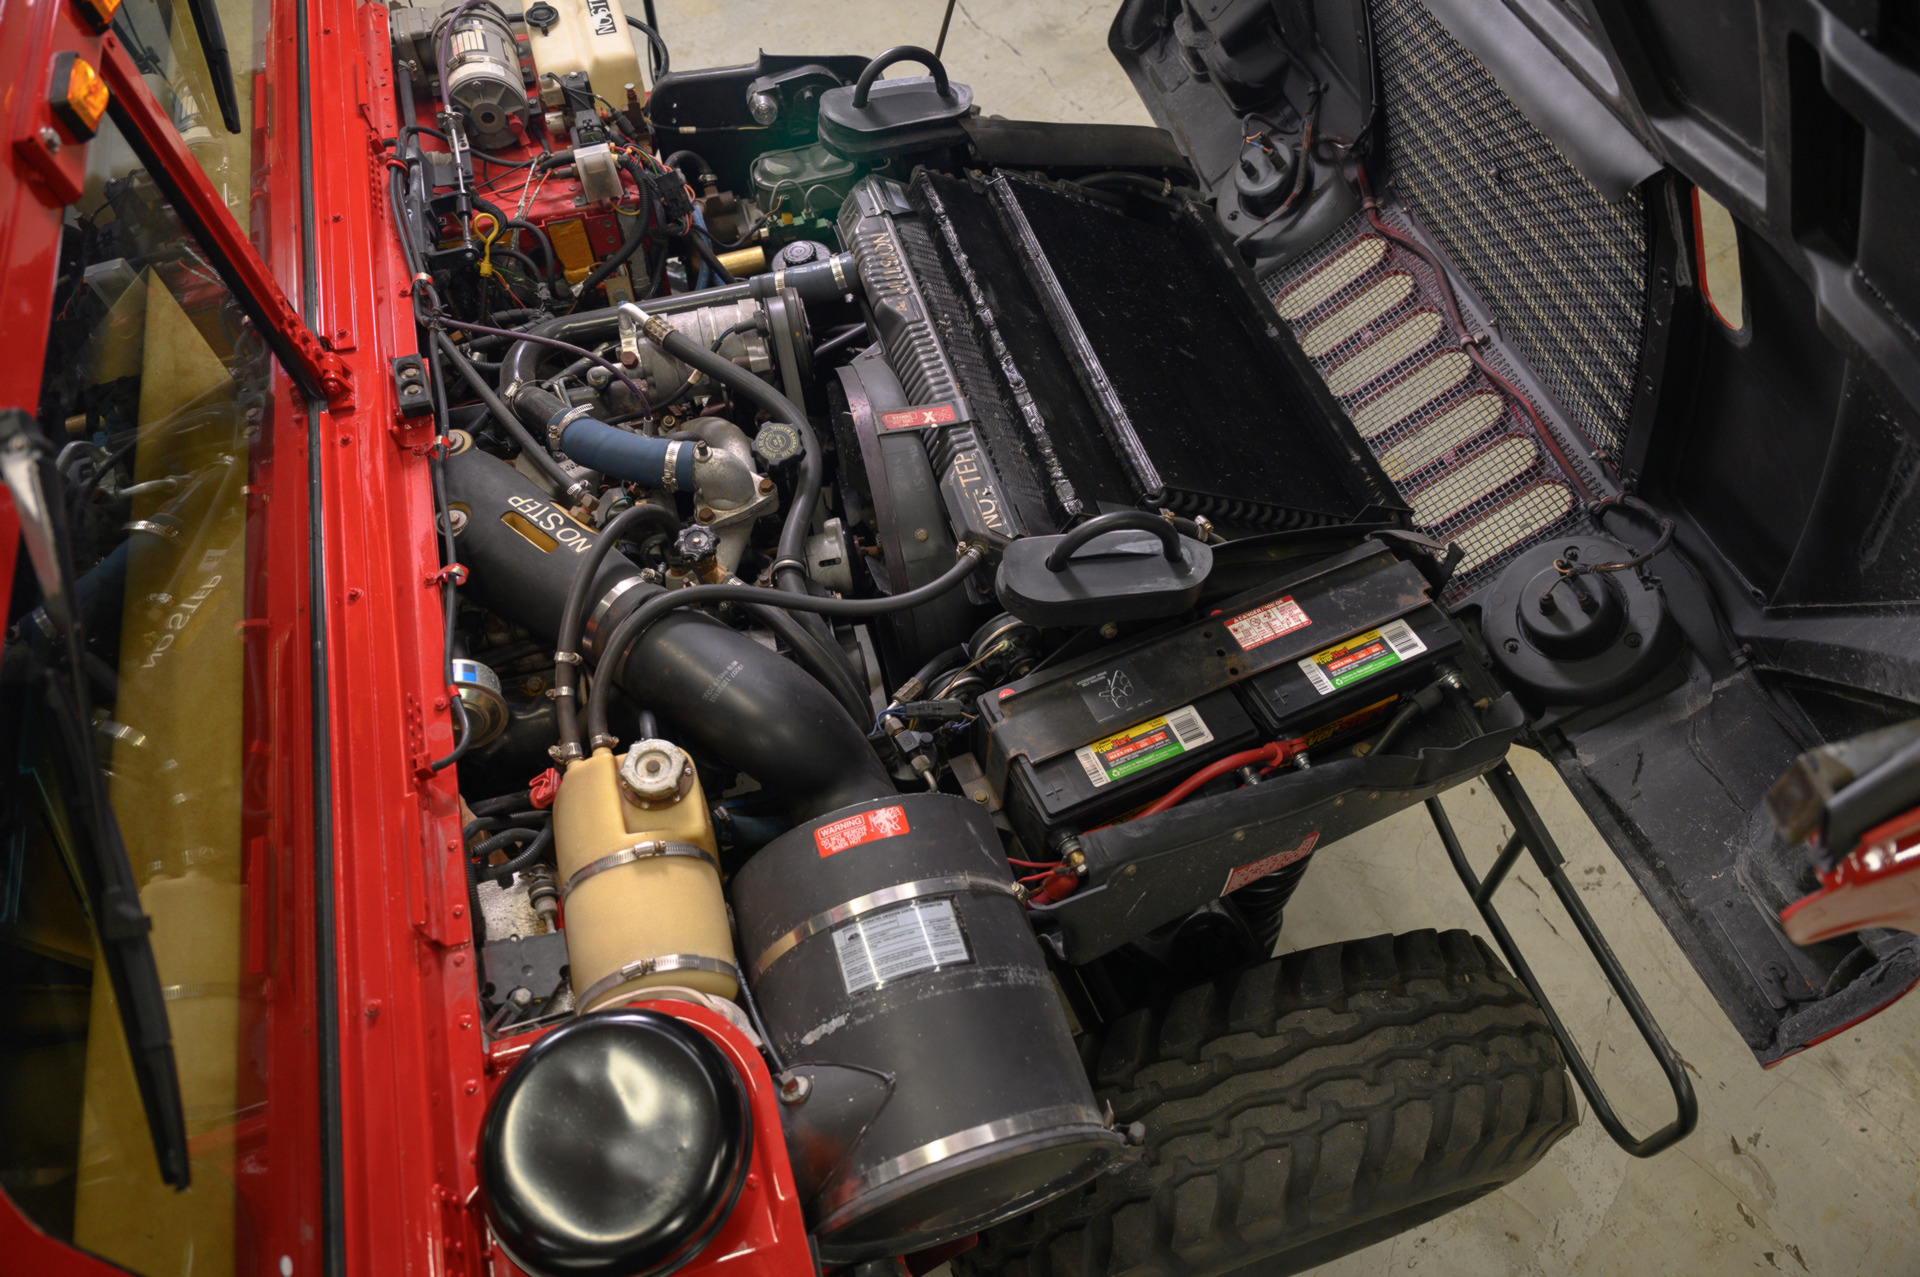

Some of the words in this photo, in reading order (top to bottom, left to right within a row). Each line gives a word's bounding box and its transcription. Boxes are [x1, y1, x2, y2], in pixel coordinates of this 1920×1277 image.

[588, 0, 610, 16] ST
[508, 496, 564, 531] STEP
[556, 527, 592, 553] NO
[1317, 647, 1350, 664] EverStart
[1307, 703, 1388, 746] verStart
[1095, 734, 1132, 754] EverStart
[1137, 755, 1155, 764] WALMART
[820, 817, 862, 837] WARNING
[830, 832, 842, 842] NOT
[844, 825, 868, 836] REMOVE
[848, 830, 867, 840] TOUCH
